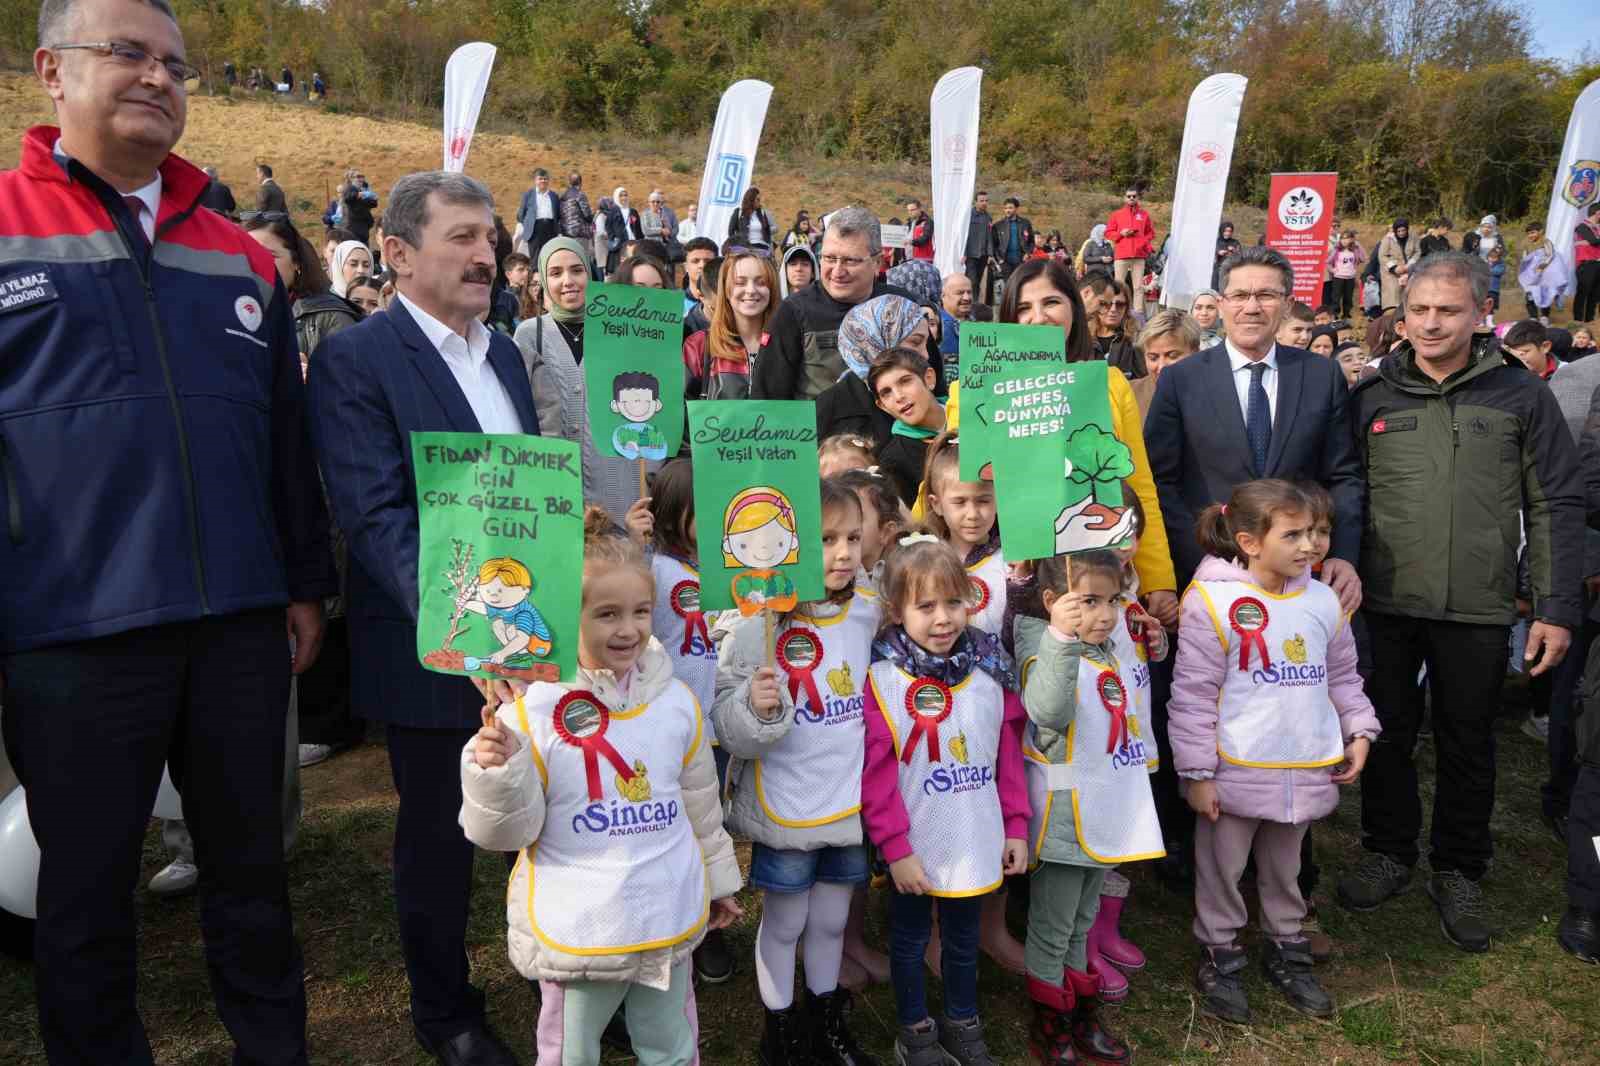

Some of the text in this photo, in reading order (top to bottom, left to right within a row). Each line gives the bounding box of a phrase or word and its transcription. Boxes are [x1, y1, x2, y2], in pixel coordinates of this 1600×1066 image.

[1284, 215, 1315, 225] YSTM
[6, 272, 49, 292] YILMAZ
[601, 320, 665, 341] Yeşil Vatan
[1008, 418, 1065, 438] NEFES!
[716, 447, 797, 464] Yeşil Vatan
[423, 490, 463, 508] ÇOK
[468, 492, 538, 513] GÜZEL
[483, 514, 539, 541] GÜN
[1253, 661, 1325, 684] Sincap
[572, 799, 678, 834] Sincap
[608, 823, 667, 837] ANAOKULU
